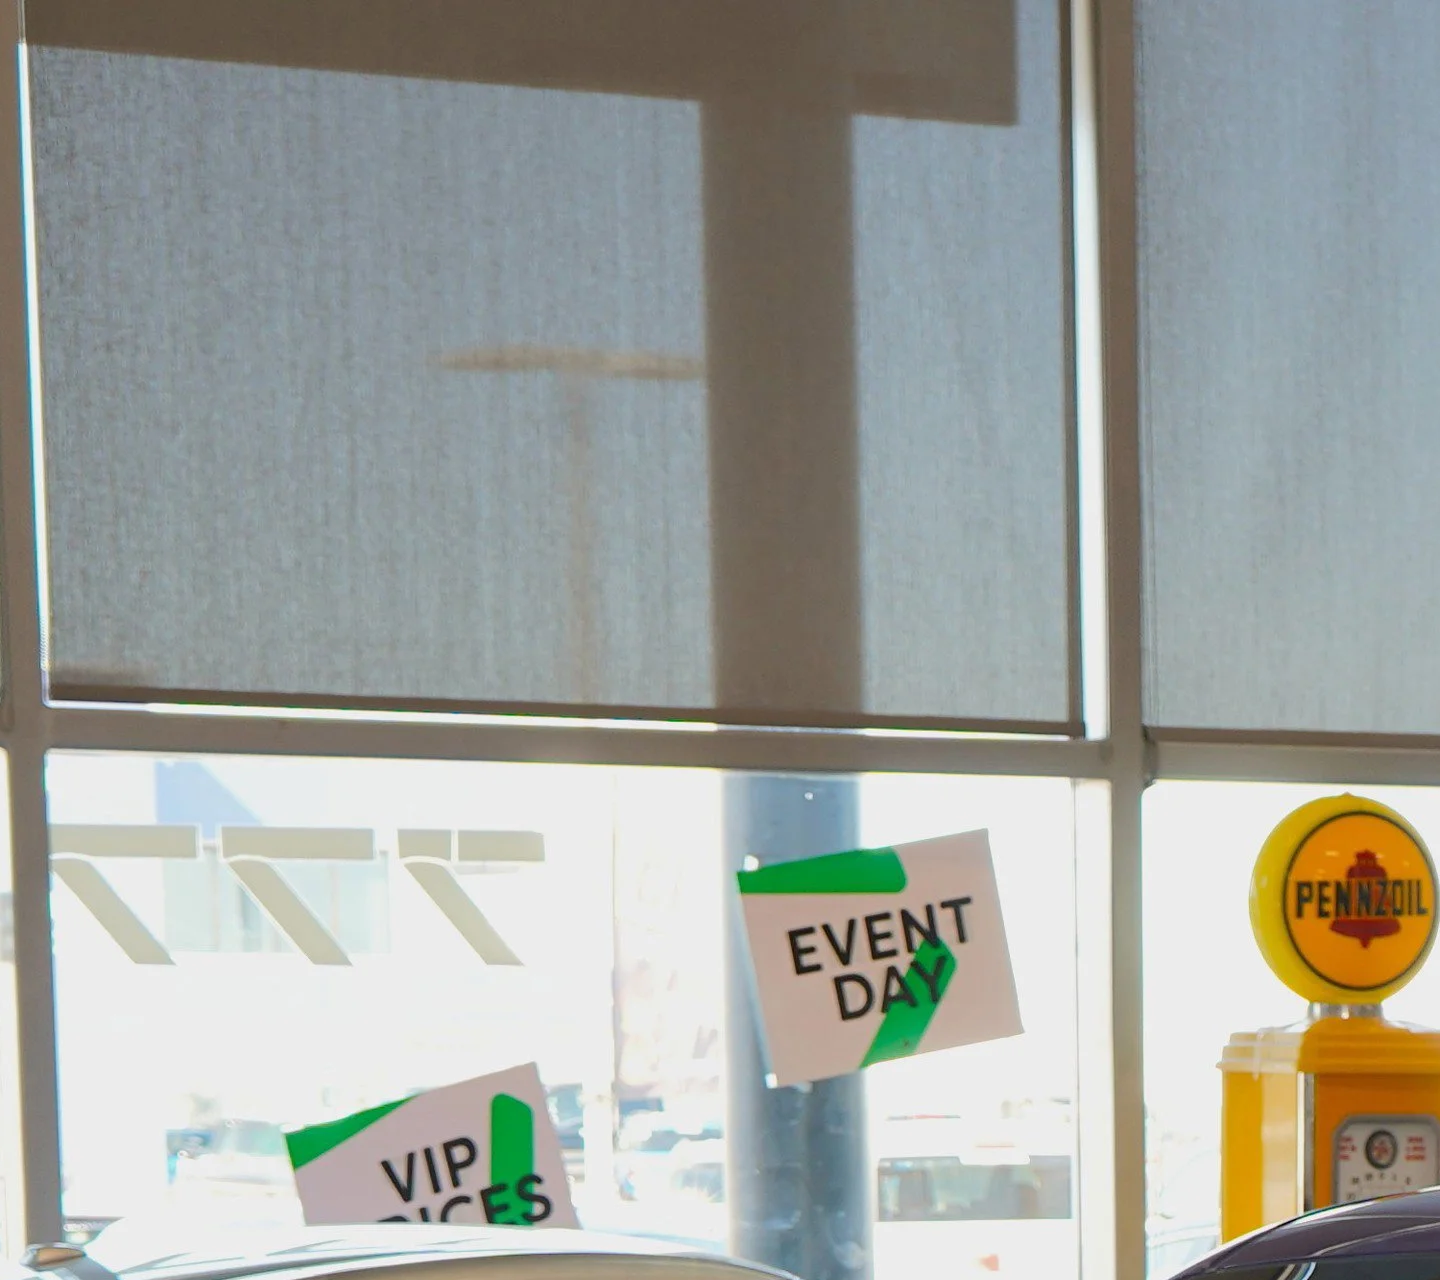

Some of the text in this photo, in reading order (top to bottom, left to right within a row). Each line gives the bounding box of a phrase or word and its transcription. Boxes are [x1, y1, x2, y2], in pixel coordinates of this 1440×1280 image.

[1295, 879, 1429, 919] PENNZOIL
[787, 896, 973, 976] EVENT
[833, 955, 948, 1022] DAY
[380, 1136, 479, 1203] VIP
